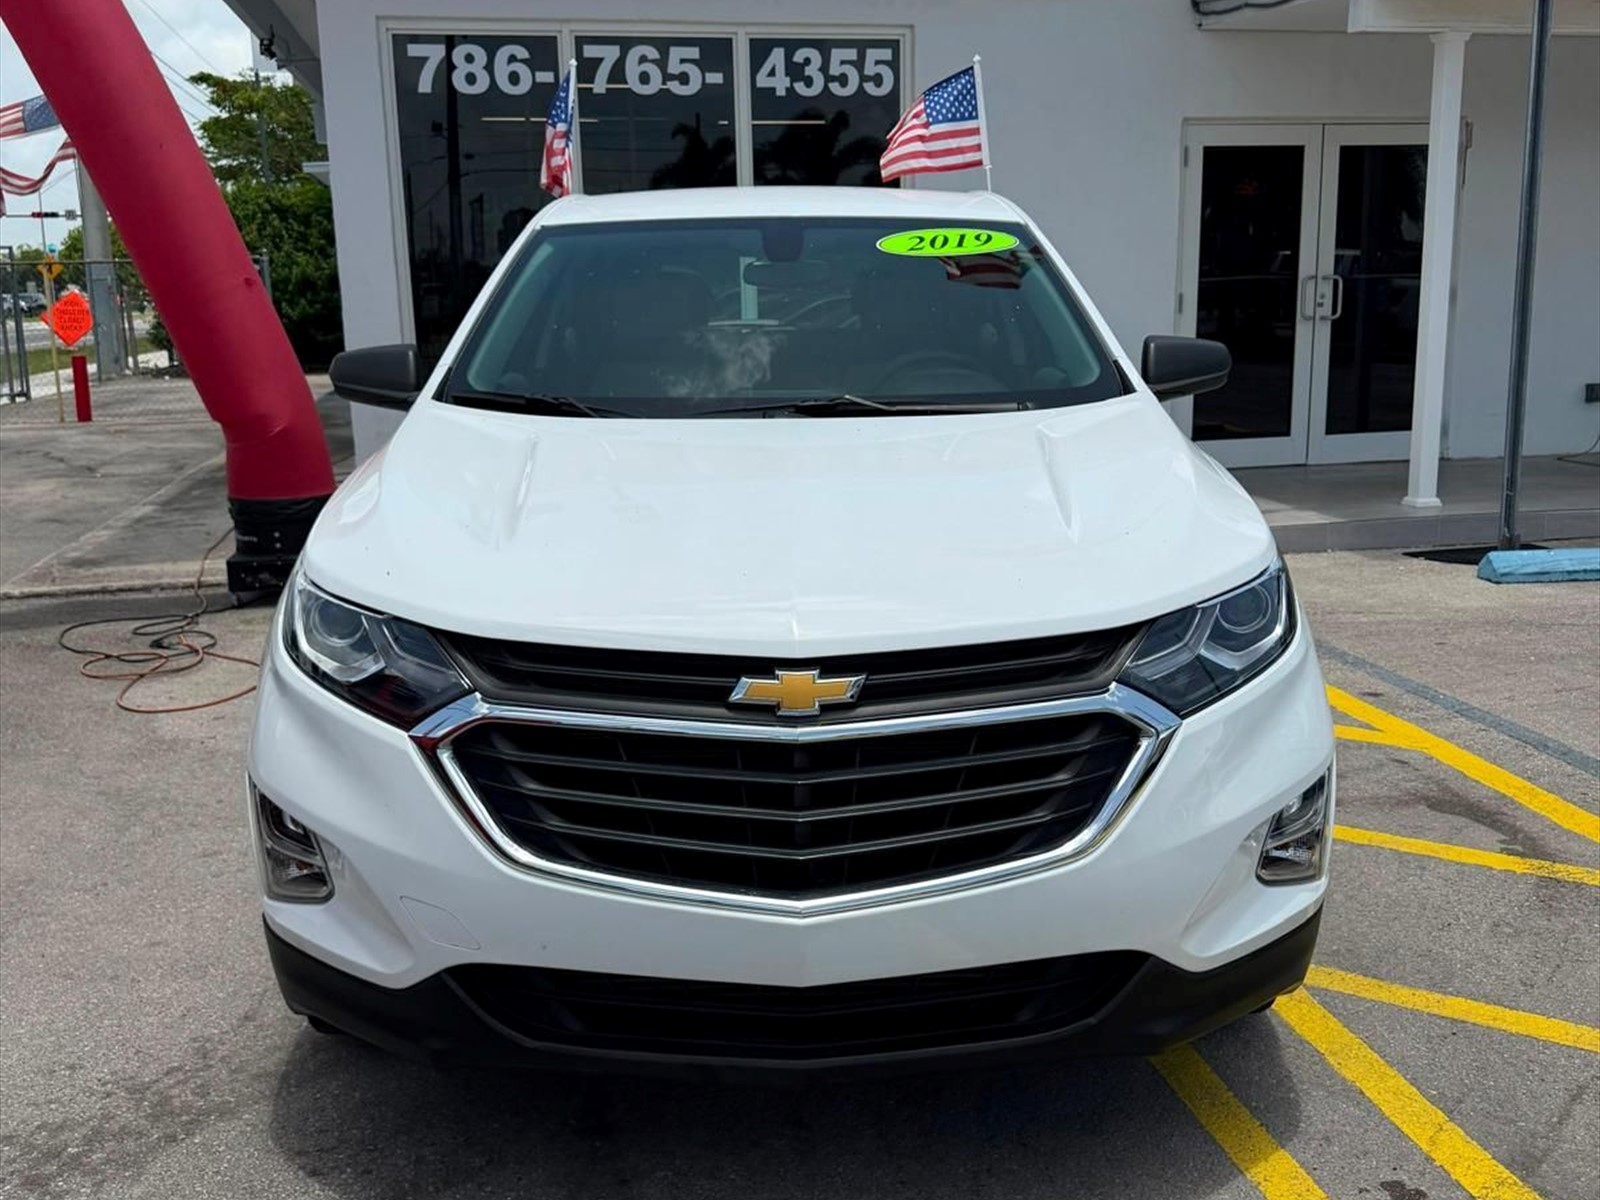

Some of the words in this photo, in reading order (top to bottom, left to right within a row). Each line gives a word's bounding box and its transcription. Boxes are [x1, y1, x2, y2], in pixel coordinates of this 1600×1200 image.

[406, 43, 555, 96] 786-
[582, 44, 725, 96] 765-
[755, 46, 895, 98] 4355
[907, 232, 993, 252] 2019
